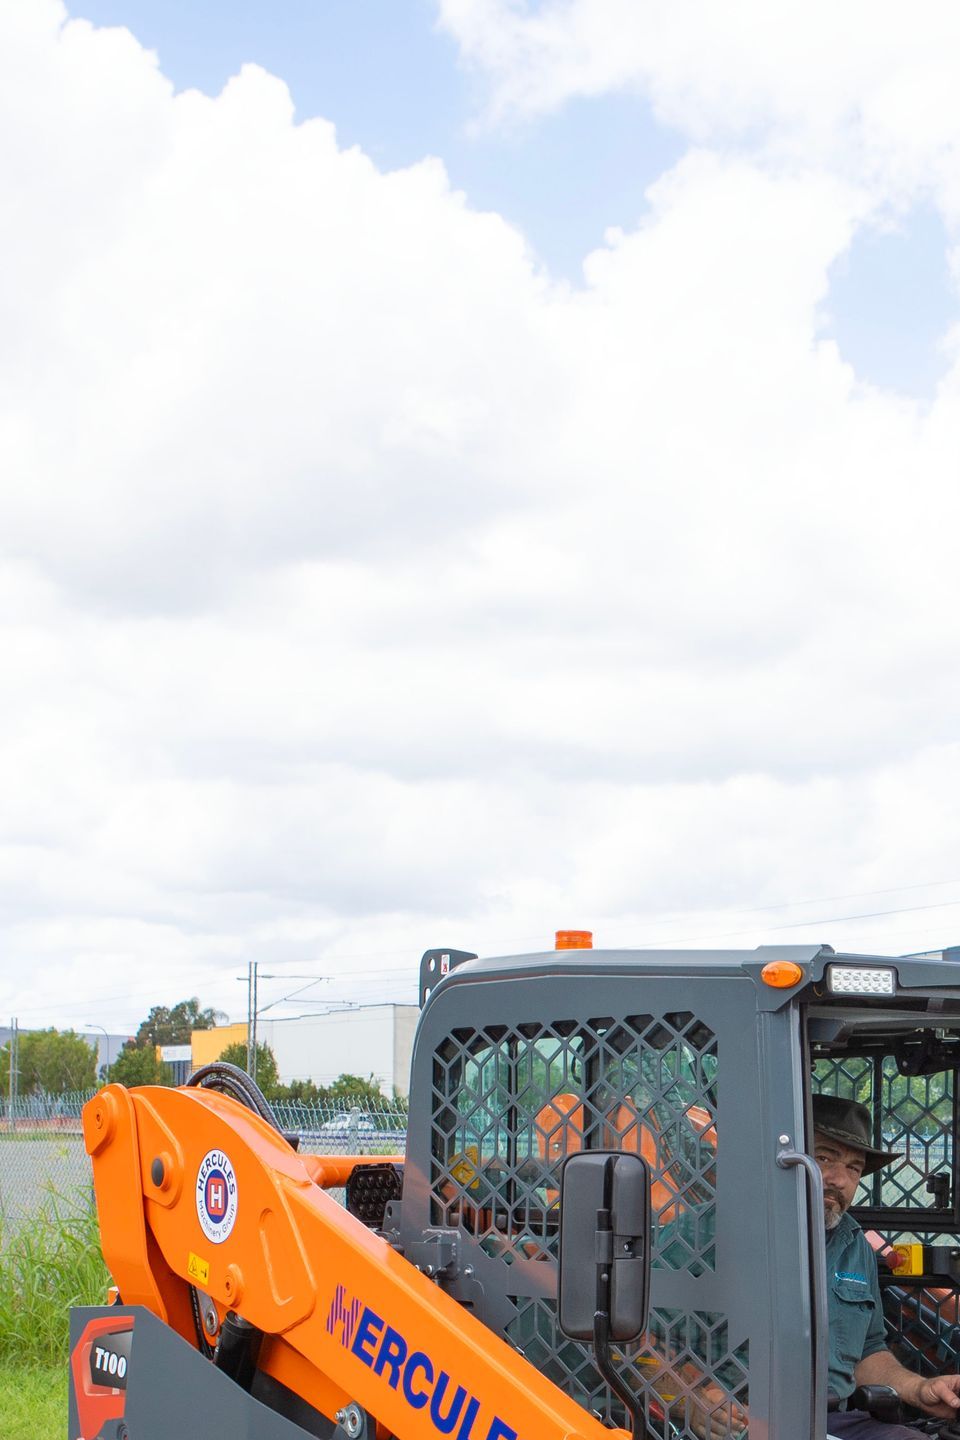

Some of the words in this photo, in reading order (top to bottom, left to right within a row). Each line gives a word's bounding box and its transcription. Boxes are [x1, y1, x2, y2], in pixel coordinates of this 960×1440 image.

[197, 1153, 236, 1196] HERCULES
[210, 1184, 223, 1209] H
[198, 1199, 222, 1239] Machinery
[221, 1203, 235, 1233] Group
[95, 1346, 127, 1379] T100
